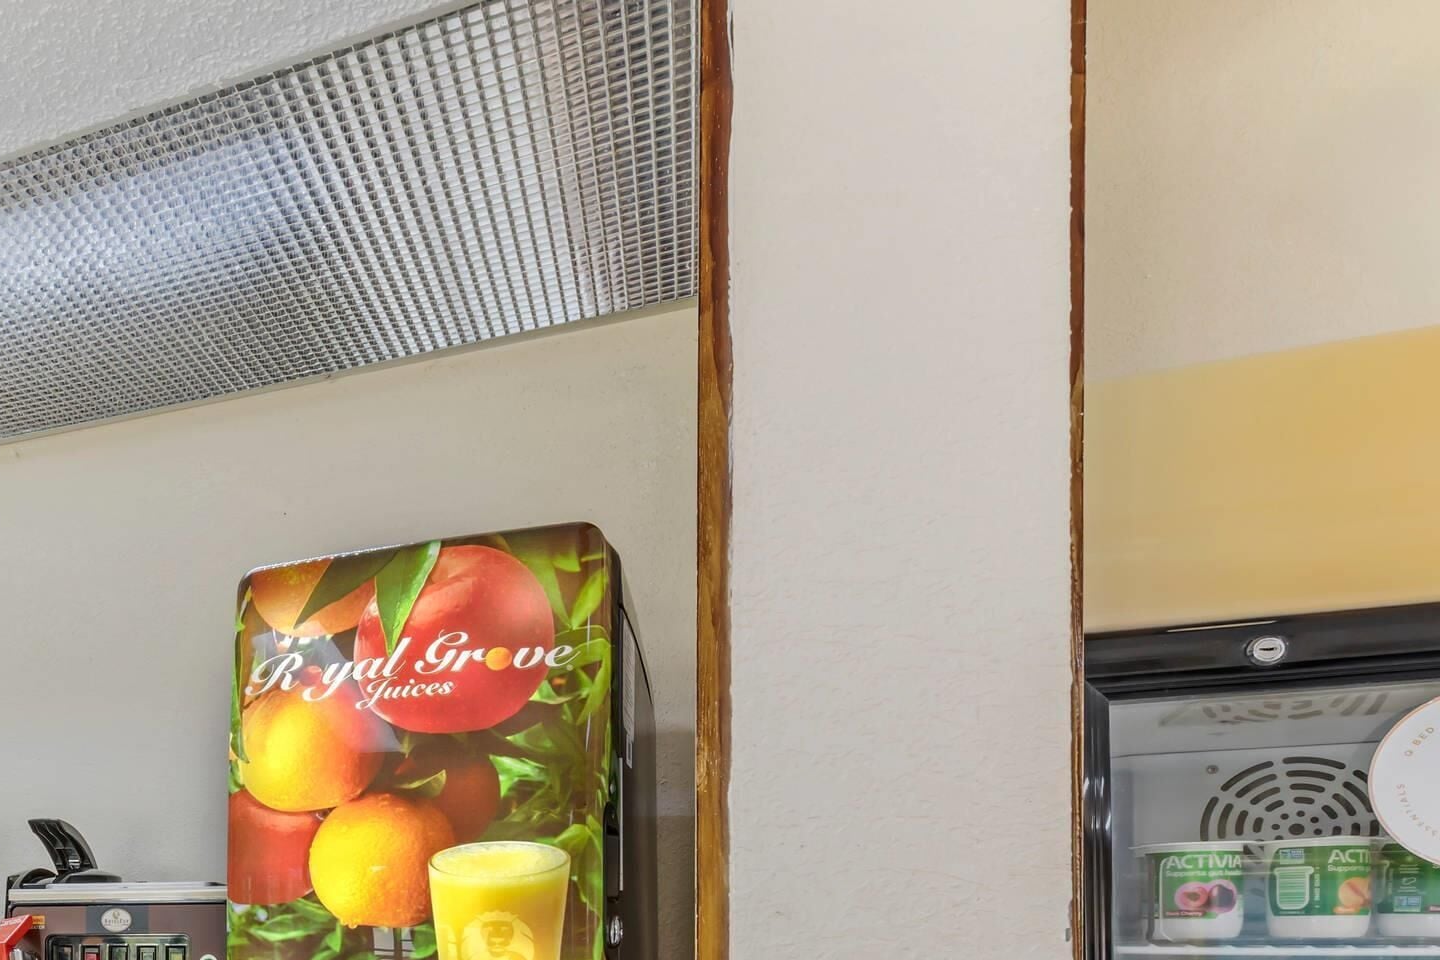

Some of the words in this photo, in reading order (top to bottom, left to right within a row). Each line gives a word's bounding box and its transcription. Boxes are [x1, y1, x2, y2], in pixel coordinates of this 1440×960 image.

[414, 629, 580, 675] Grove
[355, 676, 455, 710] Juices
[1412, 727, 1435, 747] BED
[1166, 853, 1242, 869] ACTIVIA
[1328, 849, 1371, 864] ACTI
